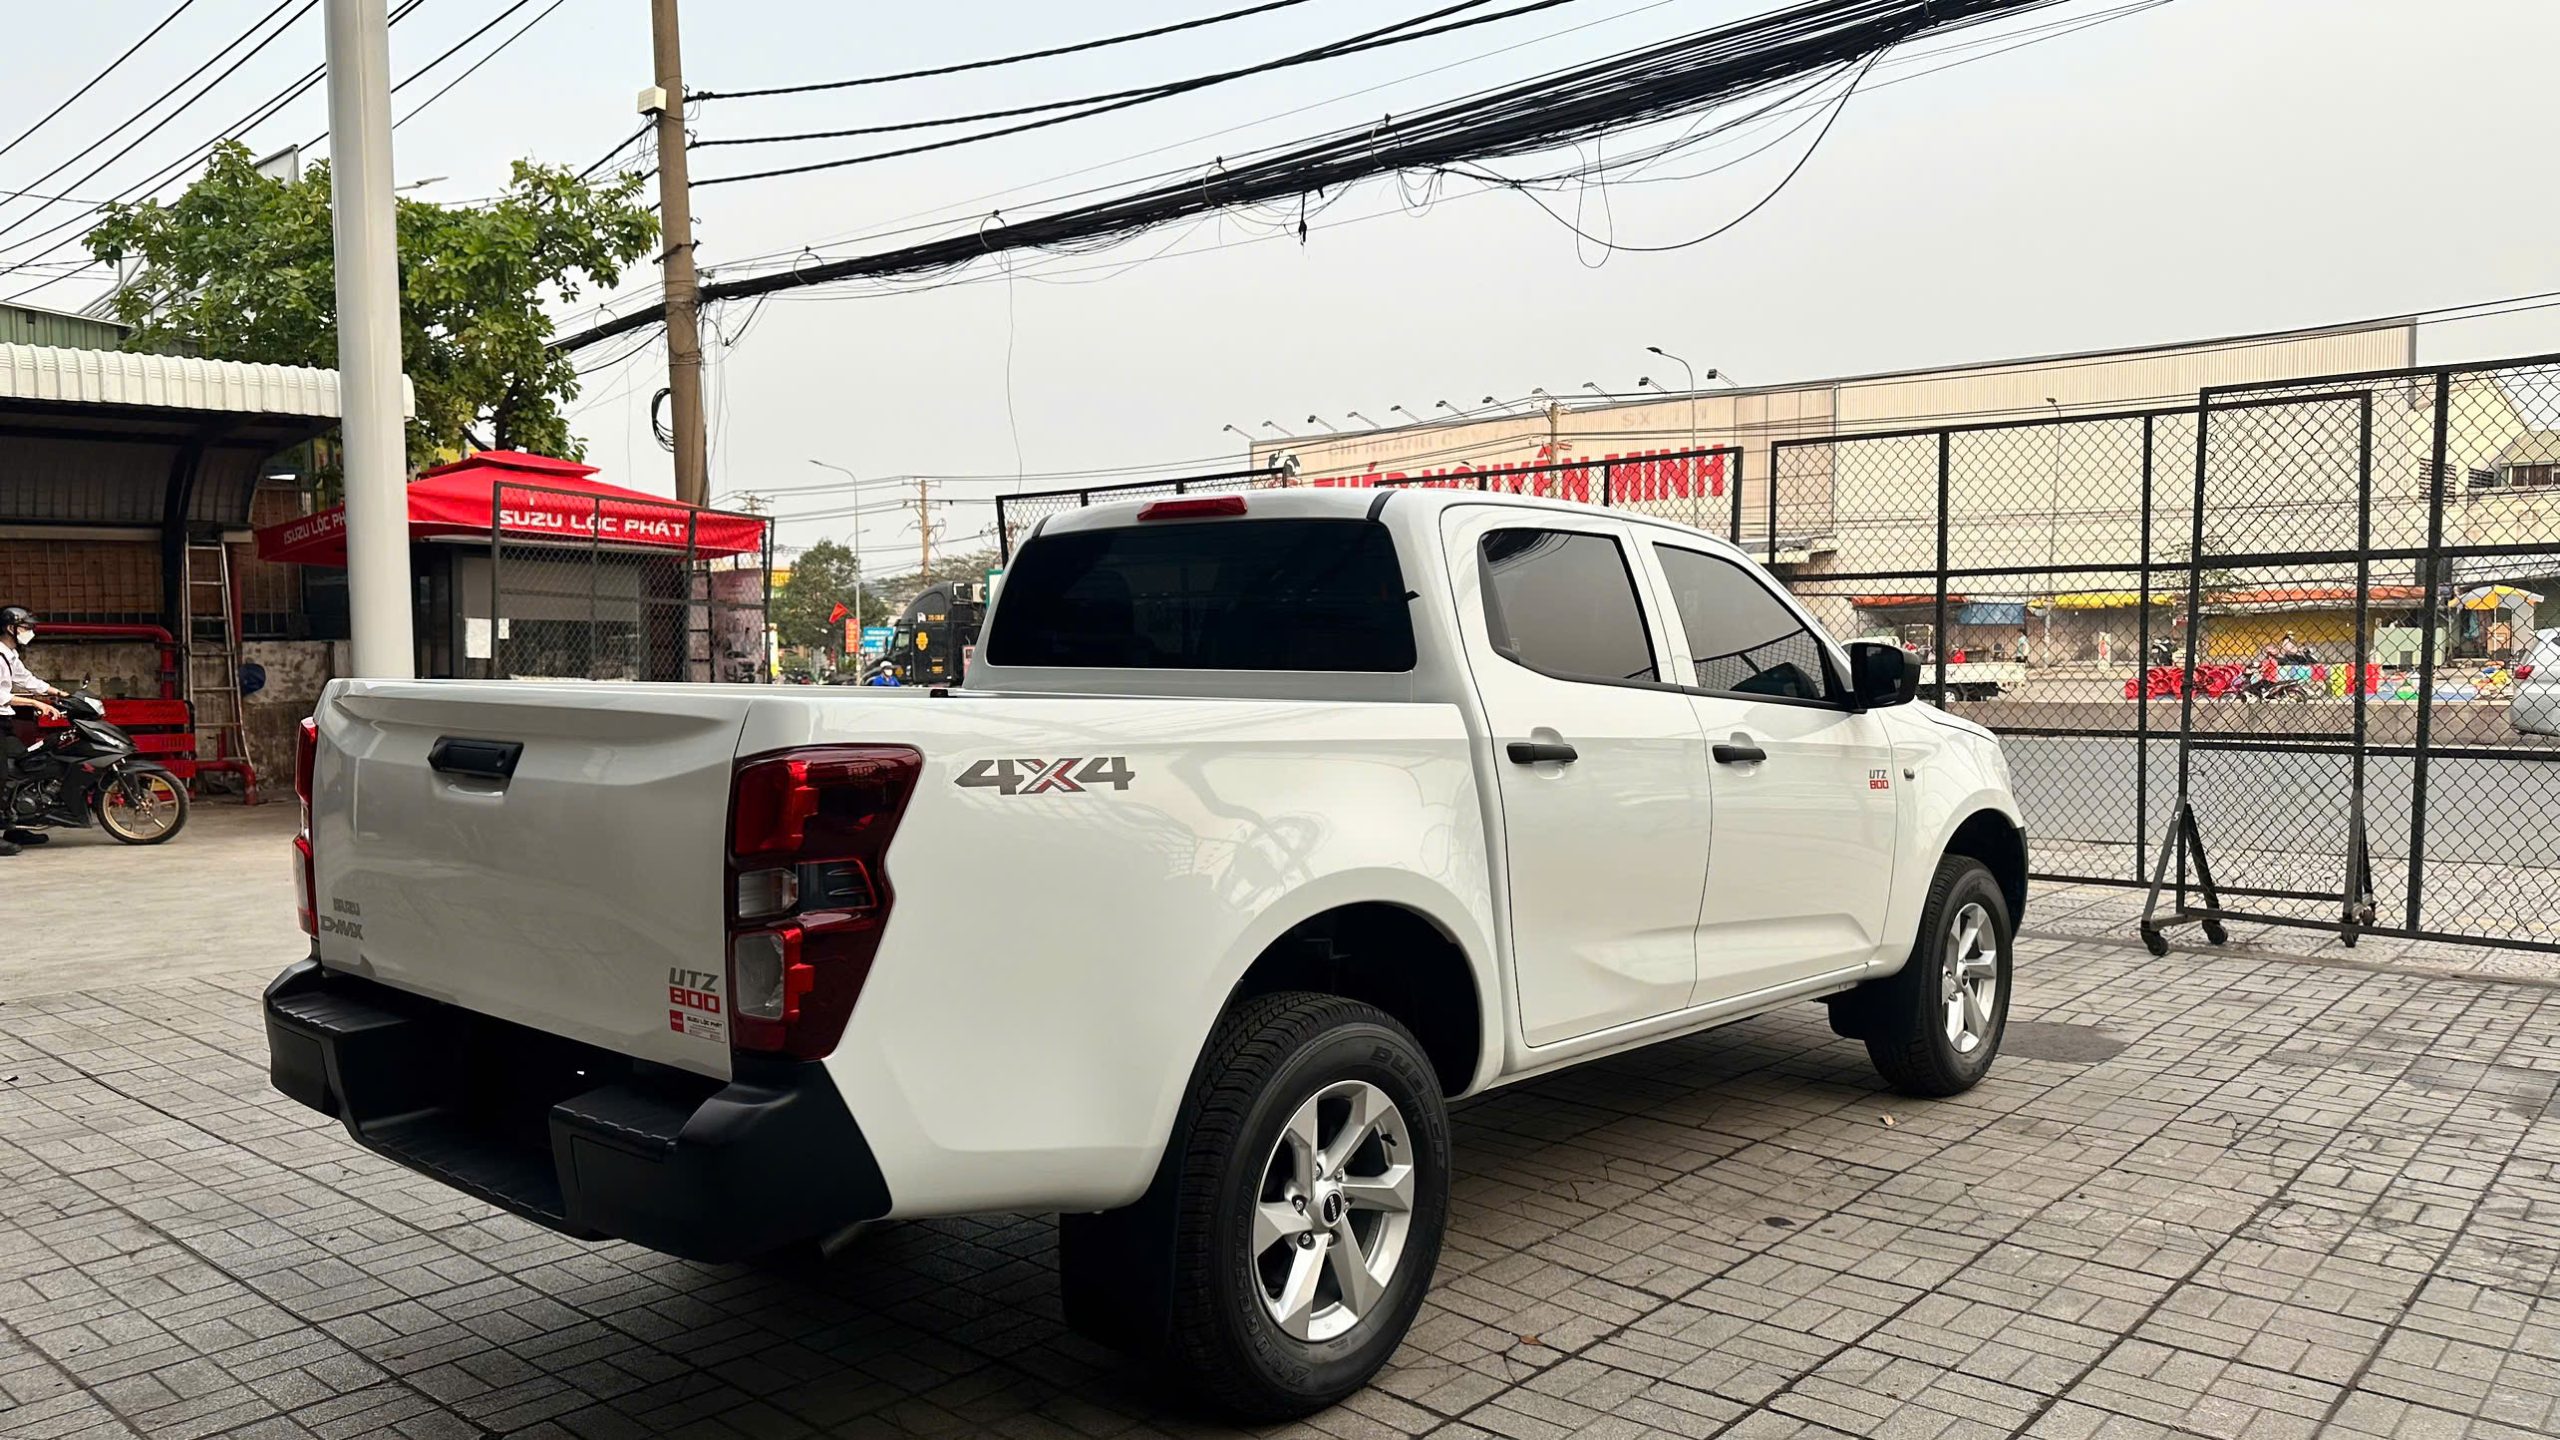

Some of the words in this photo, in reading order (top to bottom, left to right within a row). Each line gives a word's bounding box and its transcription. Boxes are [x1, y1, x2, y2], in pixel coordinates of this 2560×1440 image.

[1604, 444, 1725, 503] MINH
[283, 523, 310, 545] ISUZU
[331, 510, 346, 528] PH
[498, 509, 563, 528] SUZU
[624, 518, 685, 538] PHÁT
[1869, 769, 1887, 779] UTZ
[1869, 780, 1889, 790] 800
[669, 967, 719, 992] UTZ
[669, 986, 721, 1014] 800
